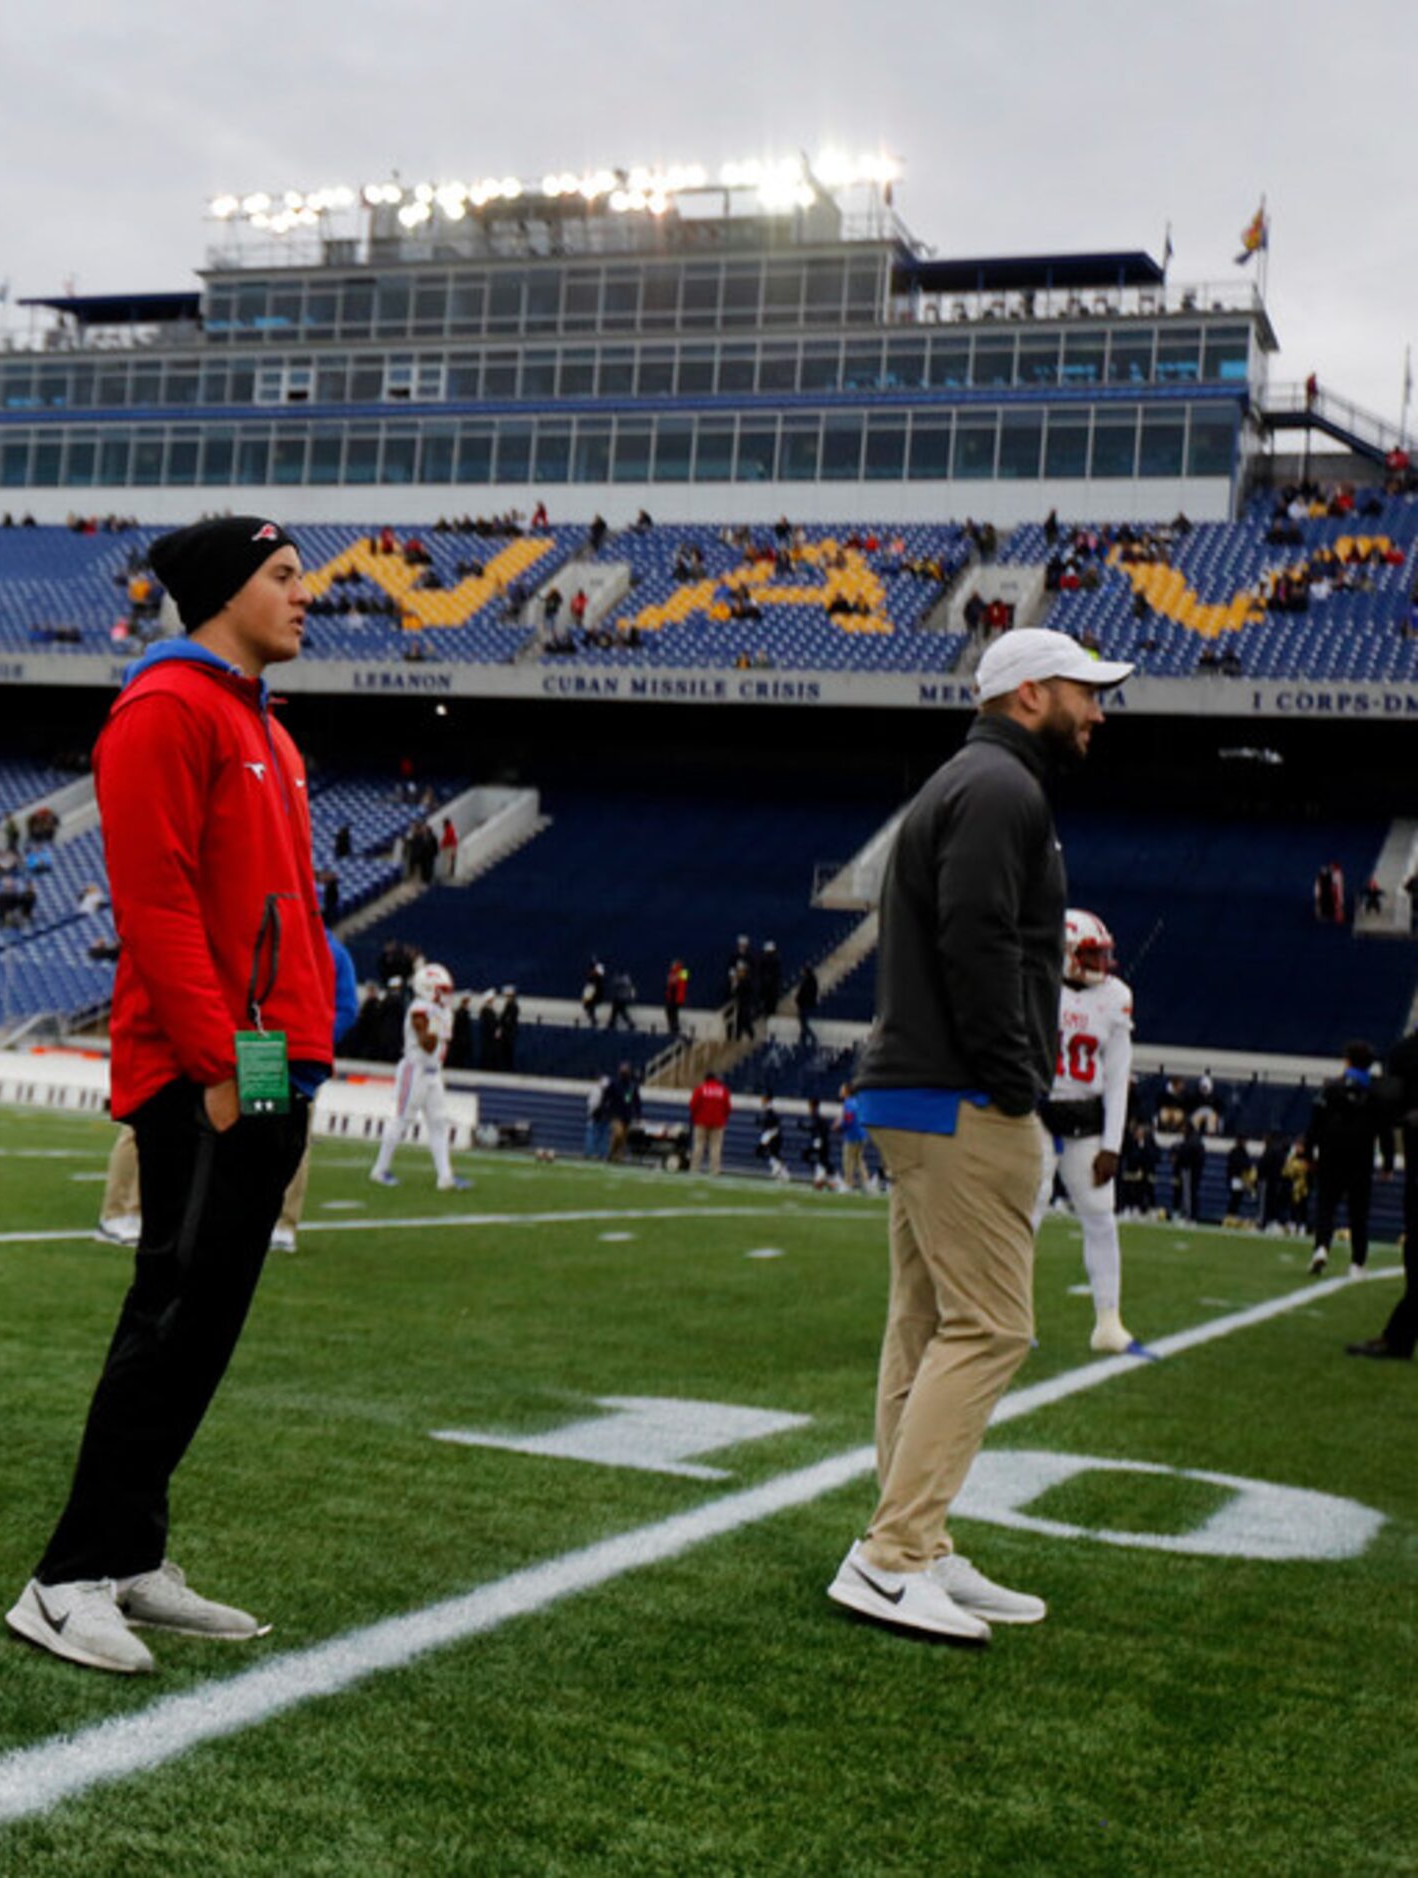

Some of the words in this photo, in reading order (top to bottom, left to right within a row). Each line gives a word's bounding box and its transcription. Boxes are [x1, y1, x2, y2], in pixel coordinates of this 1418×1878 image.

[354, 672, 452, 692] LEBANON
[544, 675, 619, 695] CUBAN
[630, 678, 727, 698] MISSILE
[739, 681, 821, 700] CRISIS
[1253, 691, 1262, 710] I
